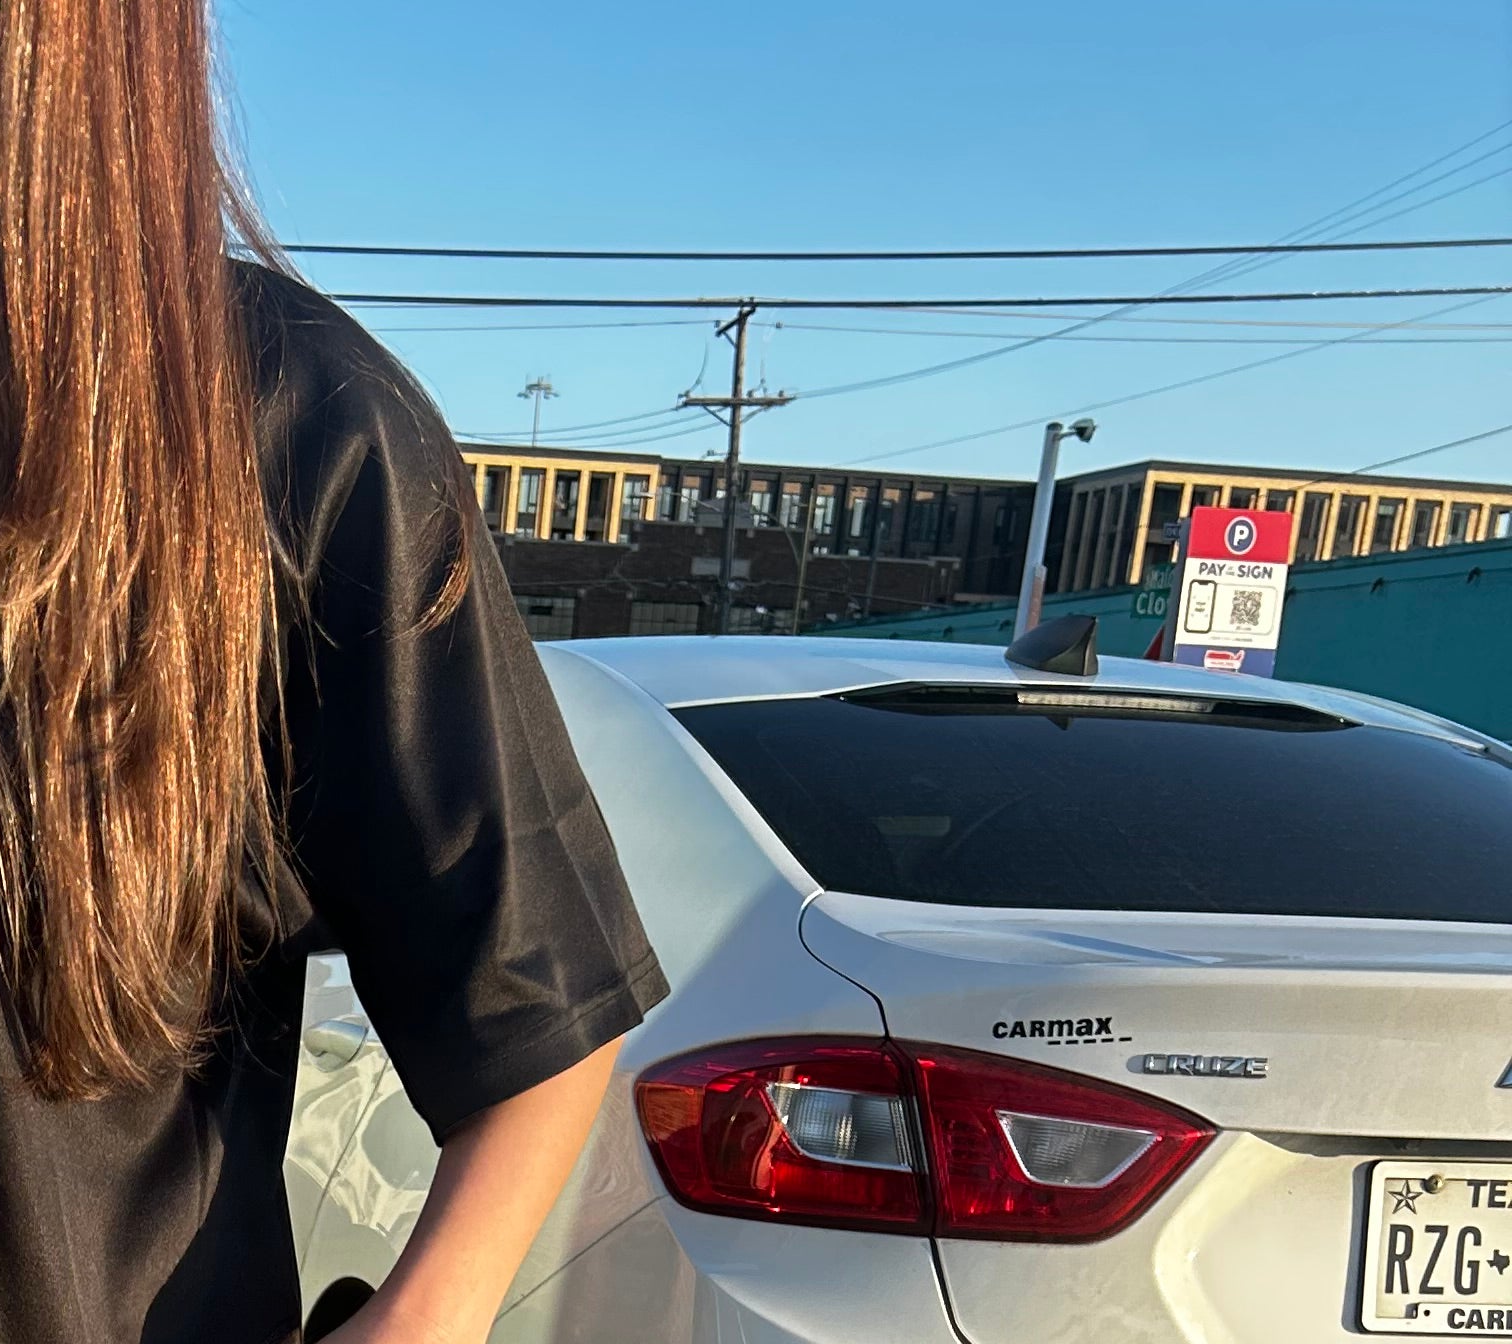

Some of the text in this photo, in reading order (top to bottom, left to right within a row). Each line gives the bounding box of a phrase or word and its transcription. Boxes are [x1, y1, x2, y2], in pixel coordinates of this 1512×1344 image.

[1233, 525, 1250, 546] P
[1198, 562, 1226, 577] PAY
[1237, 565, 1273, 580] SIGN
[1143, 1053, 1269, 1079] CRUZE
[1467, 1179, 1512, 1209] TE
[1384, 1223, 1483, 1296] RZG
[1447, 1308, 1512, 1330] CAR
